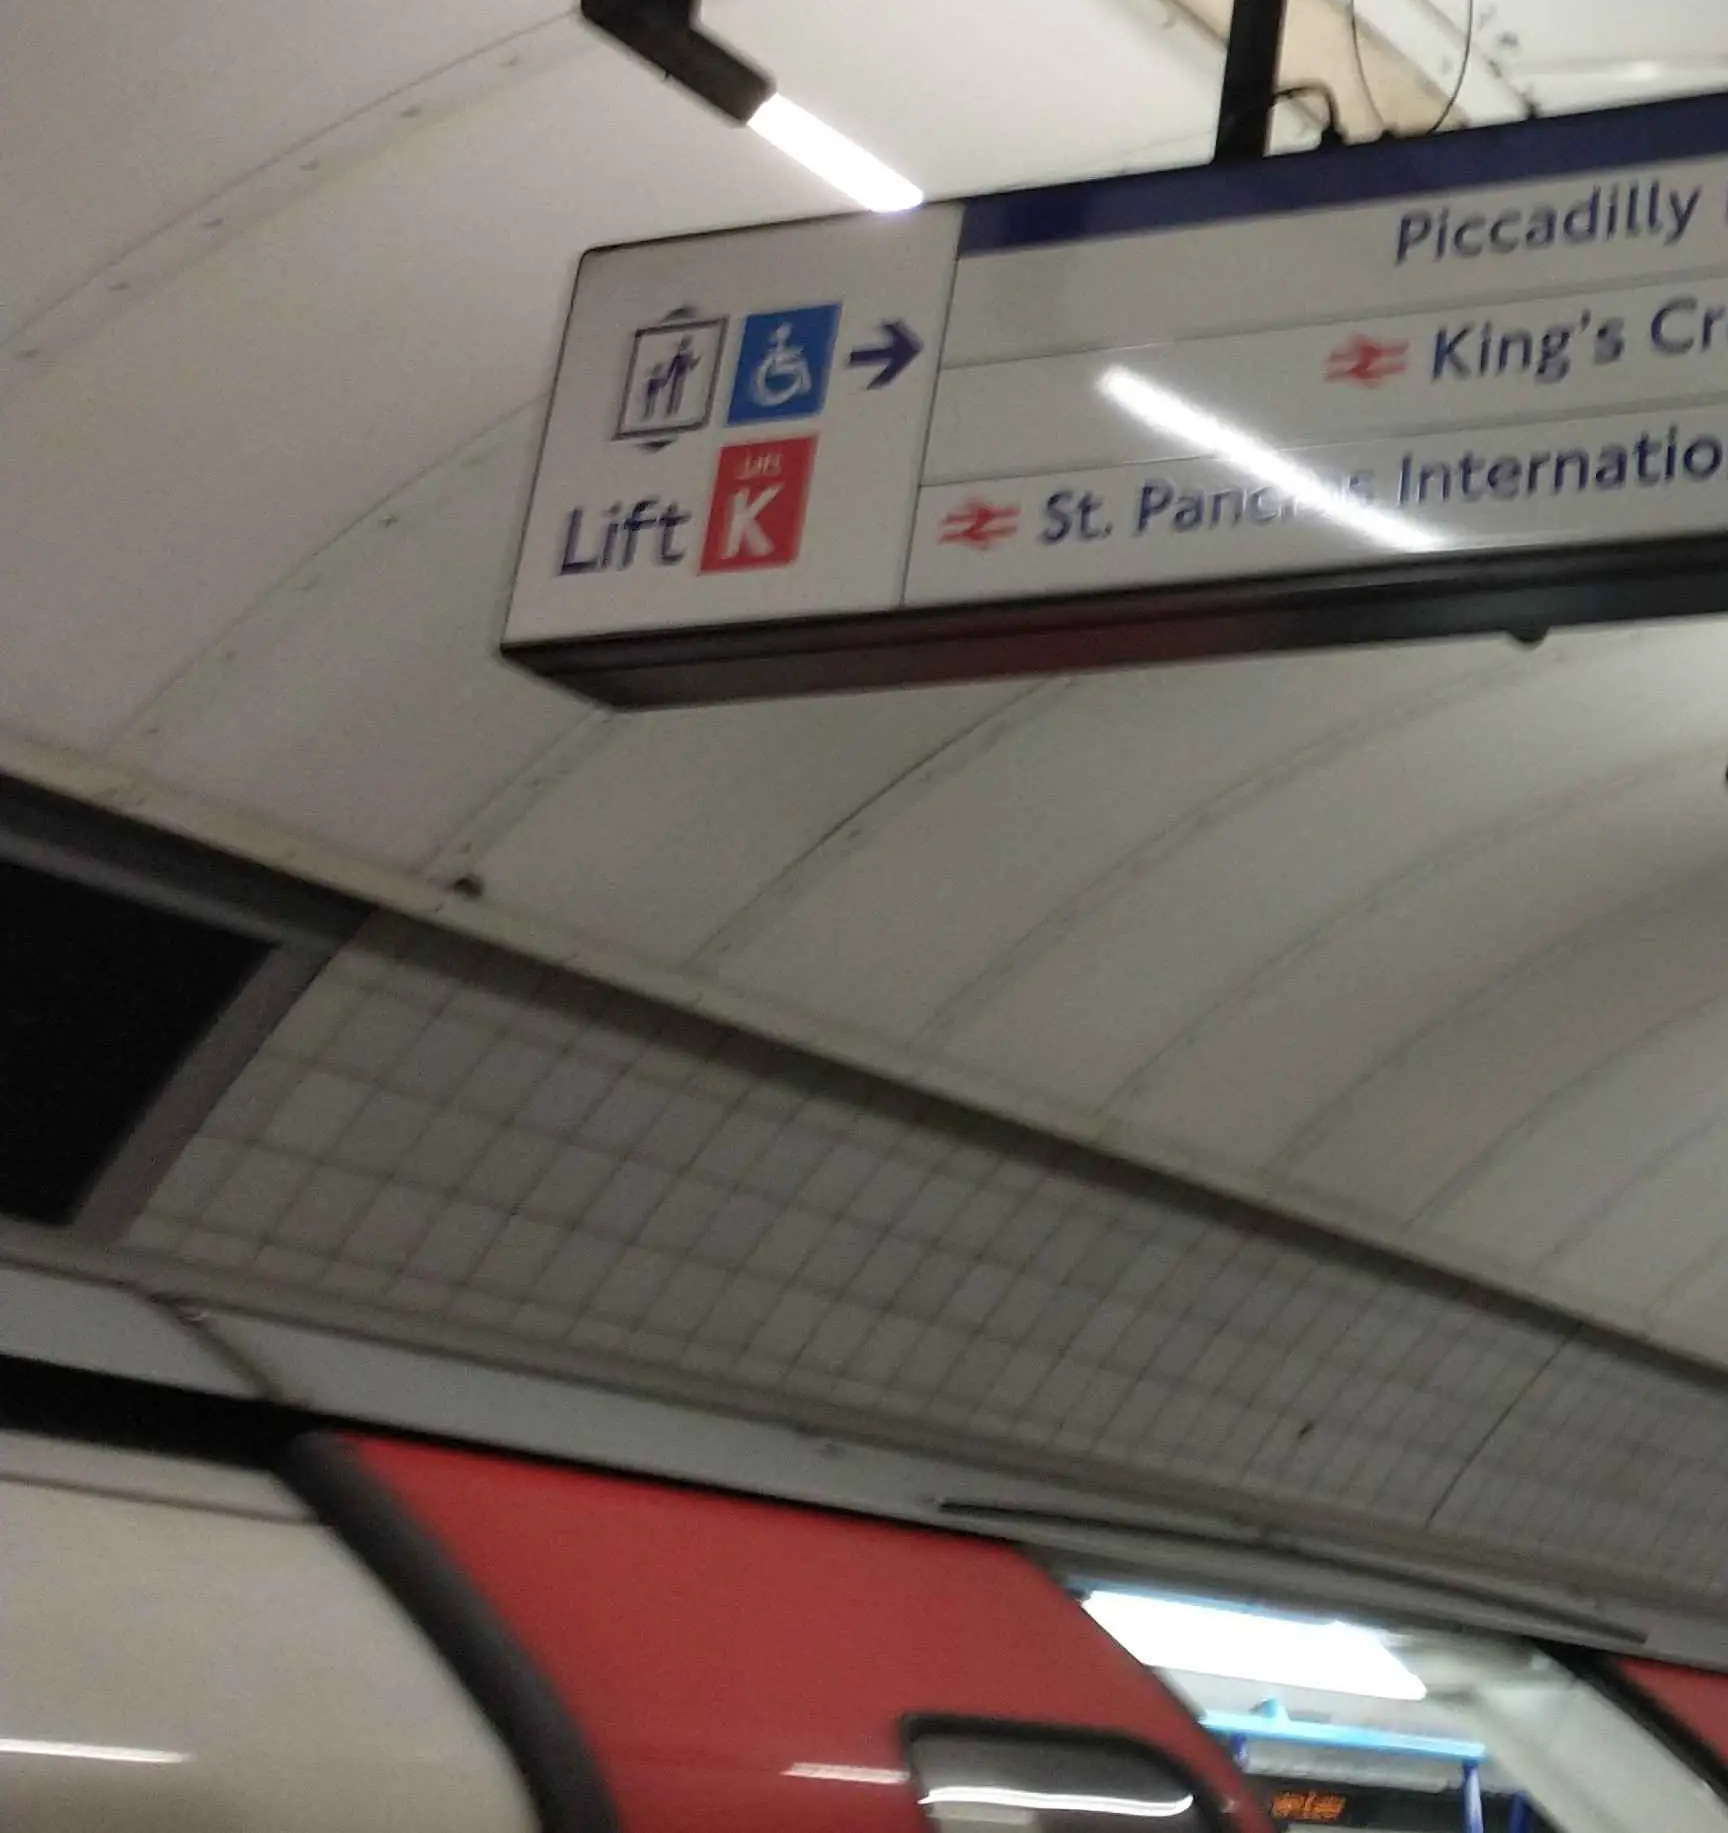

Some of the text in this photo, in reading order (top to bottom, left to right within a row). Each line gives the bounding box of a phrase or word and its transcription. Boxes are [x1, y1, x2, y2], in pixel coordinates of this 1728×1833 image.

[1396, 180, 1701, 266] Piccadilly
[1431, 309, 1624, 385] King's
[560, 482, 783, 577] Lift K
[1037, 487, 1113, 546] St.
[1132, 467, 1374, 536] Pancs
